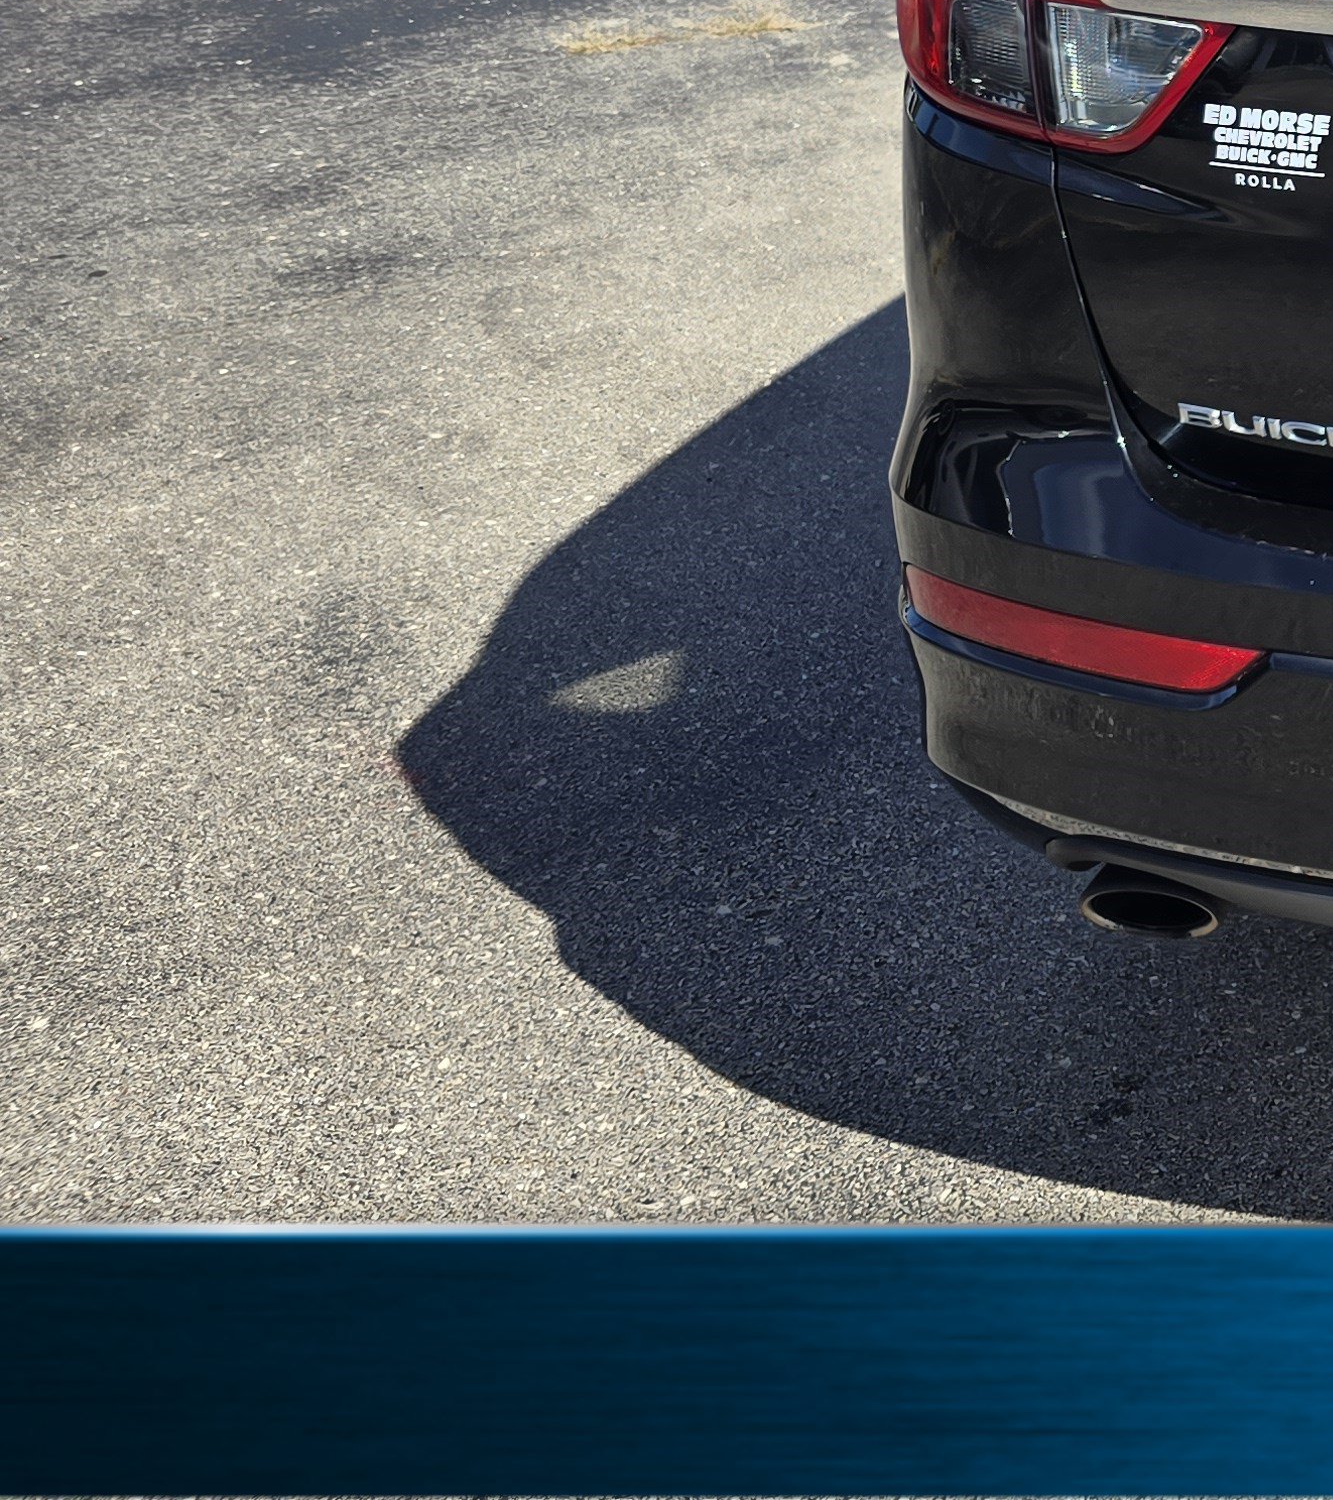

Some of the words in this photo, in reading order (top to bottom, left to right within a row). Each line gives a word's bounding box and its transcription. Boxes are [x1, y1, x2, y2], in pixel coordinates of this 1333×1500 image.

[1203, 103, 1237, 126] ED
[1239, 107, 1332, 136] MORSE
[1213, 126, 1323, 152] CHEVROLET
[1234, 172, 1297, 192] ROLLA
